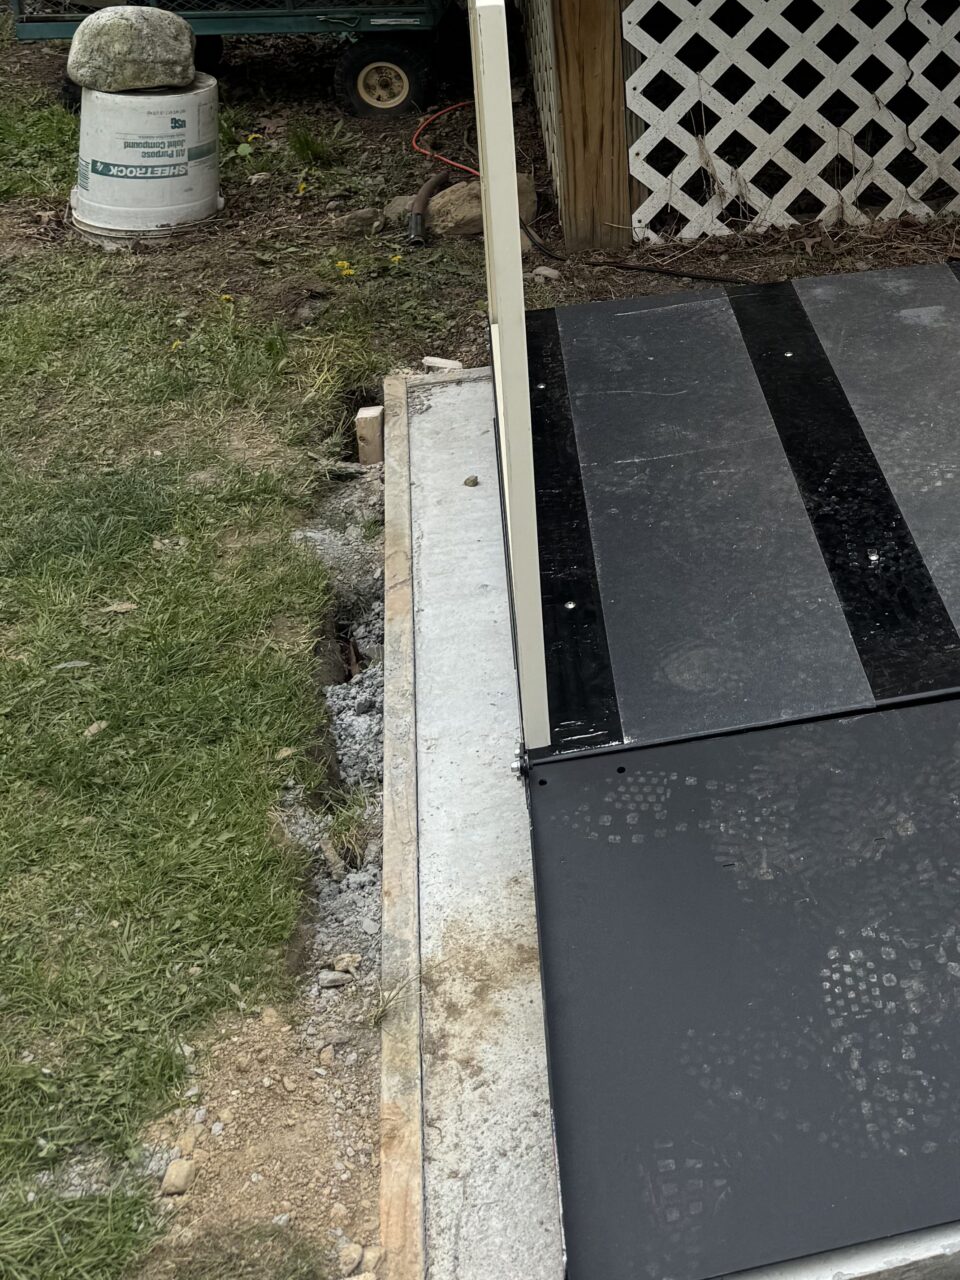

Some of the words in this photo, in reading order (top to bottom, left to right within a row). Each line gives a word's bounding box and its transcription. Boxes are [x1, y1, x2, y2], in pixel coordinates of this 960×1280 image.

[171, 117, 186, 129] USG
[123, 141, 167, 150] Compound
[167, 140, 186, 148] Joint
[141, 150, 174, 158] Purpose
[176, 149, 186, 157] All
[110, 165, 187, 176] SHEETROCK
